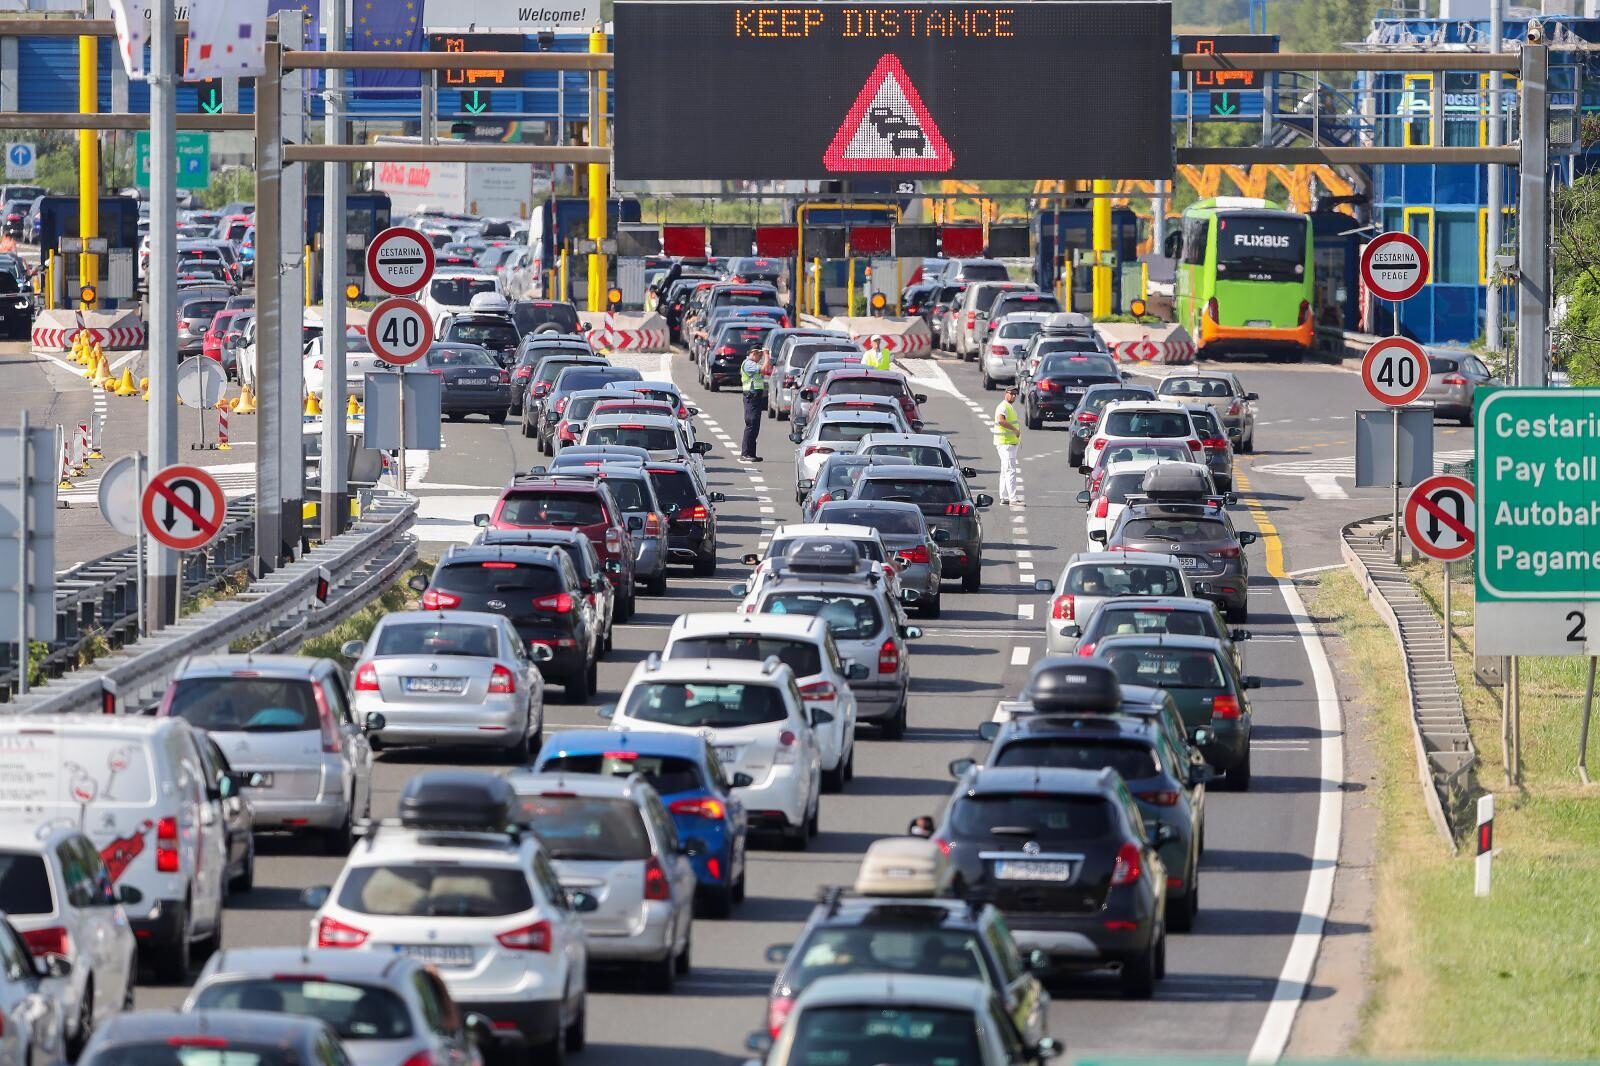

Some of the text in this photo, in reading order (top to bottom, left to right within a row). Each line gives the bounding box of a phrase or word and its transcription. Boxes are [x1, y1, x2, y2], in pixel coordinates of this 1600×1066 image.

[518, 8, 587, 22] Welcome!
[735, 9, 1014, 37] KEEP DISTANCE
[380, 247, 421, 257] CESTARINA
[1374, 253, 1415, 262] CESTARINA
[388, 266, 415, 275] PEAGE
[1381, 271, 1409, 280] PEAGE
[382, 316, 419, 347] 40
[1376, 356, 1414, 388] 40
[1495, 412, 1600, 438] Cestari
[1495, 456, 1597, 488] Pay toll
[1565, 610, 1588, 642] 2
